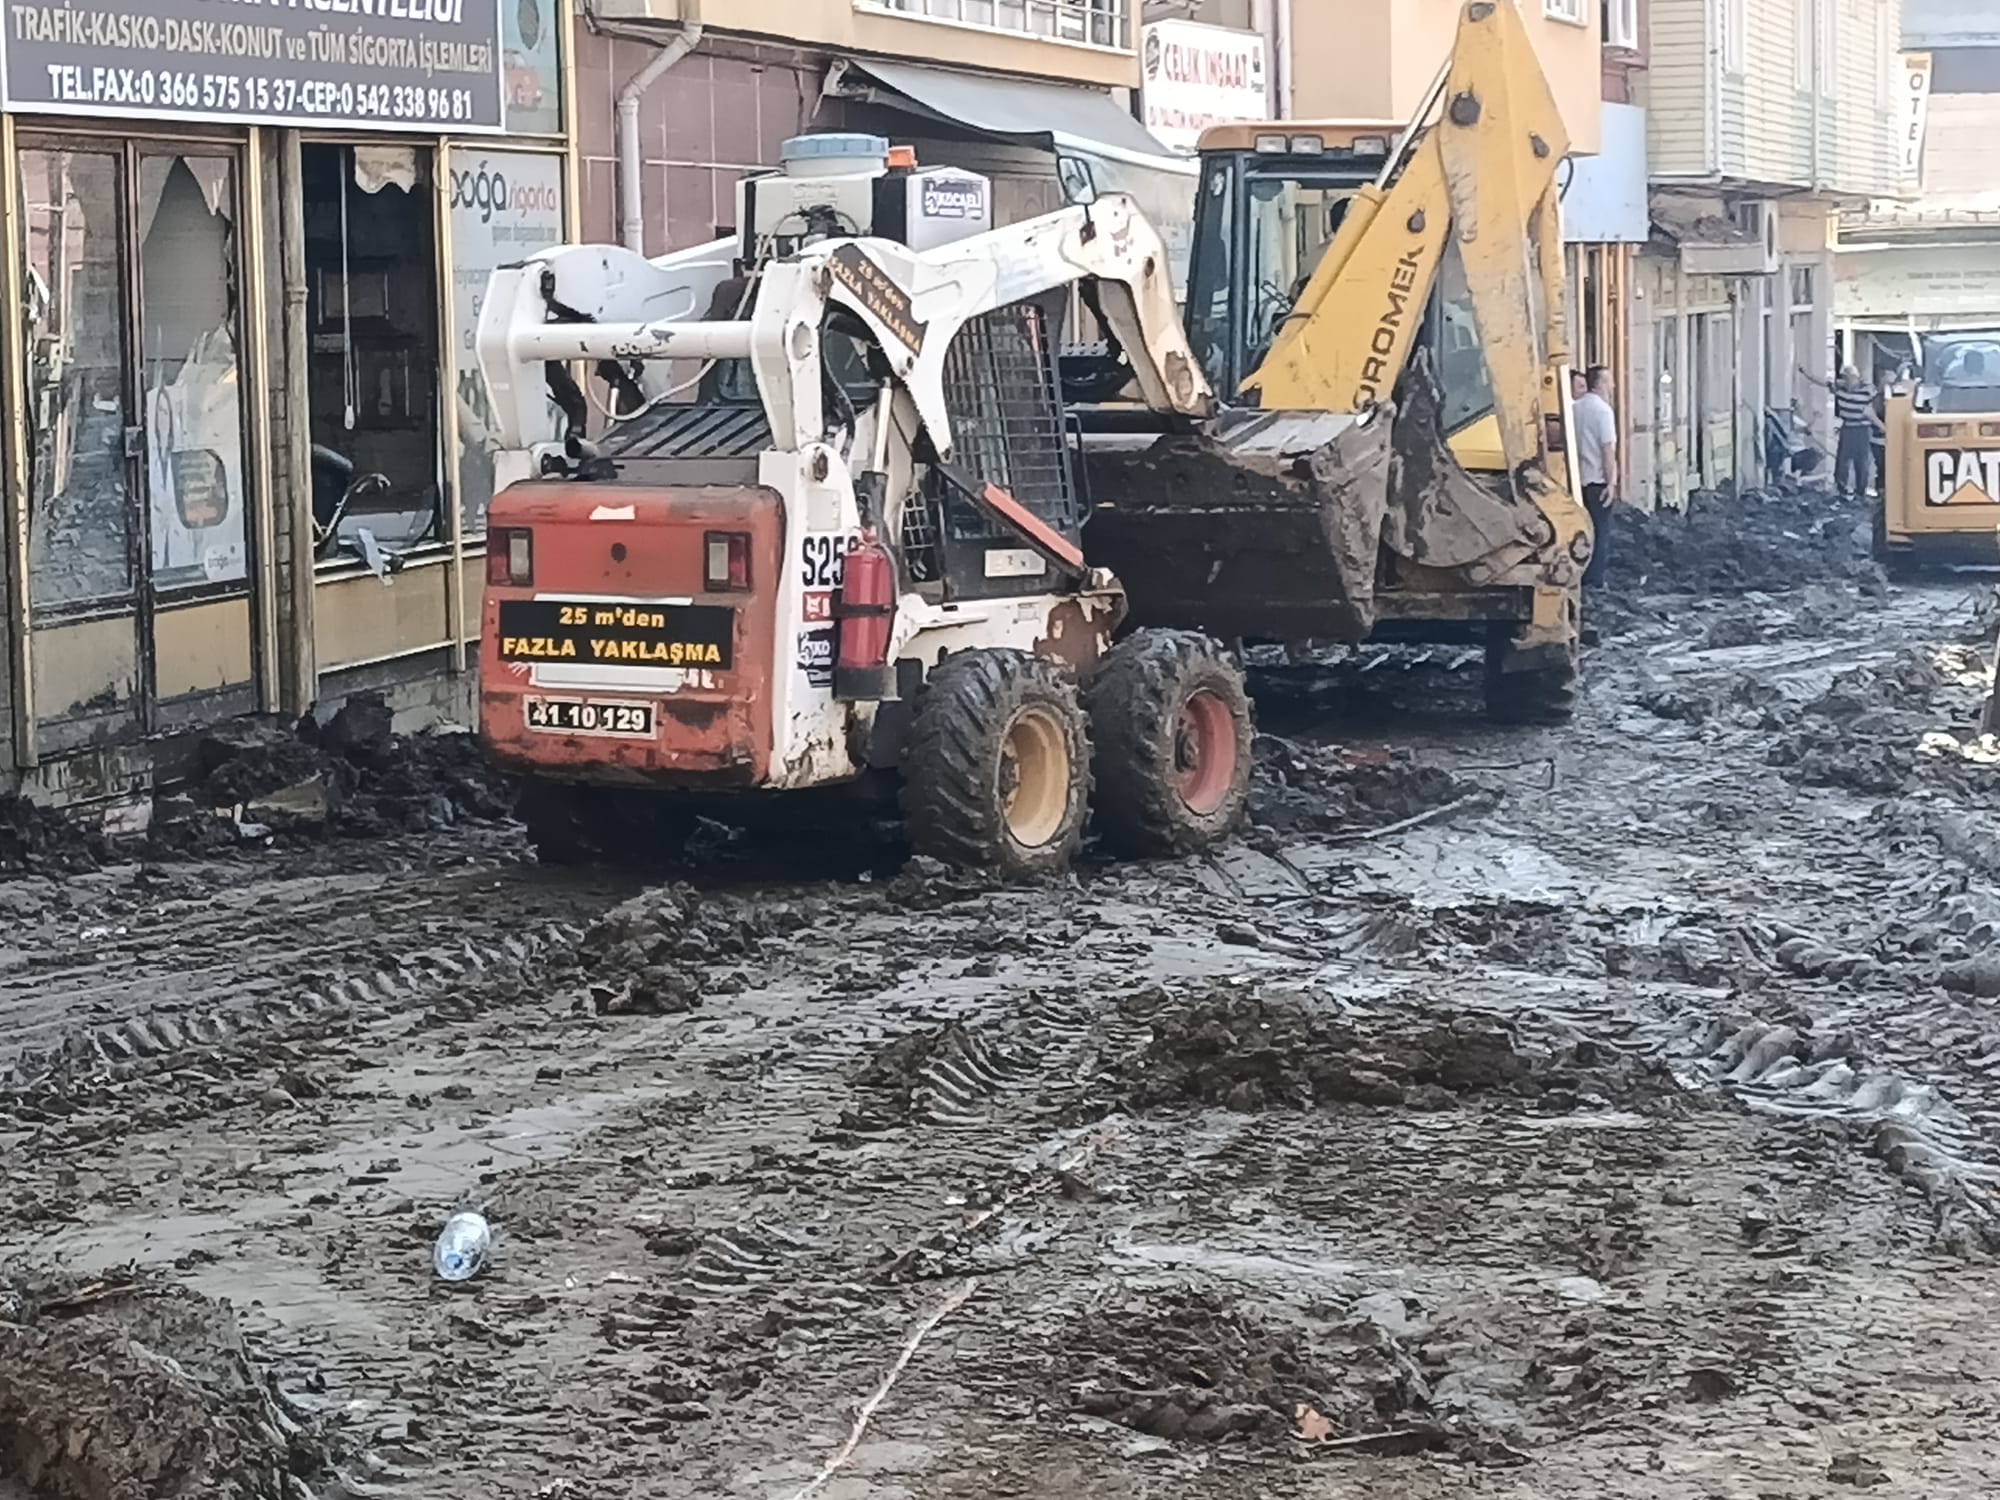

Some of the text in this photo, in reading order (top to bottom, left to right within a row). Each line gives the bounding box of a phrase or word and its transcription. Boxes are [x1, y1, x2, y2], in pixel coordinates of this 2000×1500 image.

[11, 0, 283, 58] TRAFİK-KASKO-DASK-KONUT
[286, 38, 306, 60] ve
[308, 24, 346, 63] TÜM
[349, 26, 417, 68] SİGORTA
[419, 33, 493, 78] İŞLEMLERİ
[47, 64, 472, 119] TEL.FAX:0 366 575 15 37-CEP:0 542 338 96 81
[1907, 73, 1924, 165] OTEL
[1928, 451, 2000, 504] CAT
[803, 536, 858, 586] S25
[559, 607, 665, 628] 25 m'den
[503, 638, 721, 666] FAZLA YAKLAŞMA
[601, 708, 645, 731] 129
